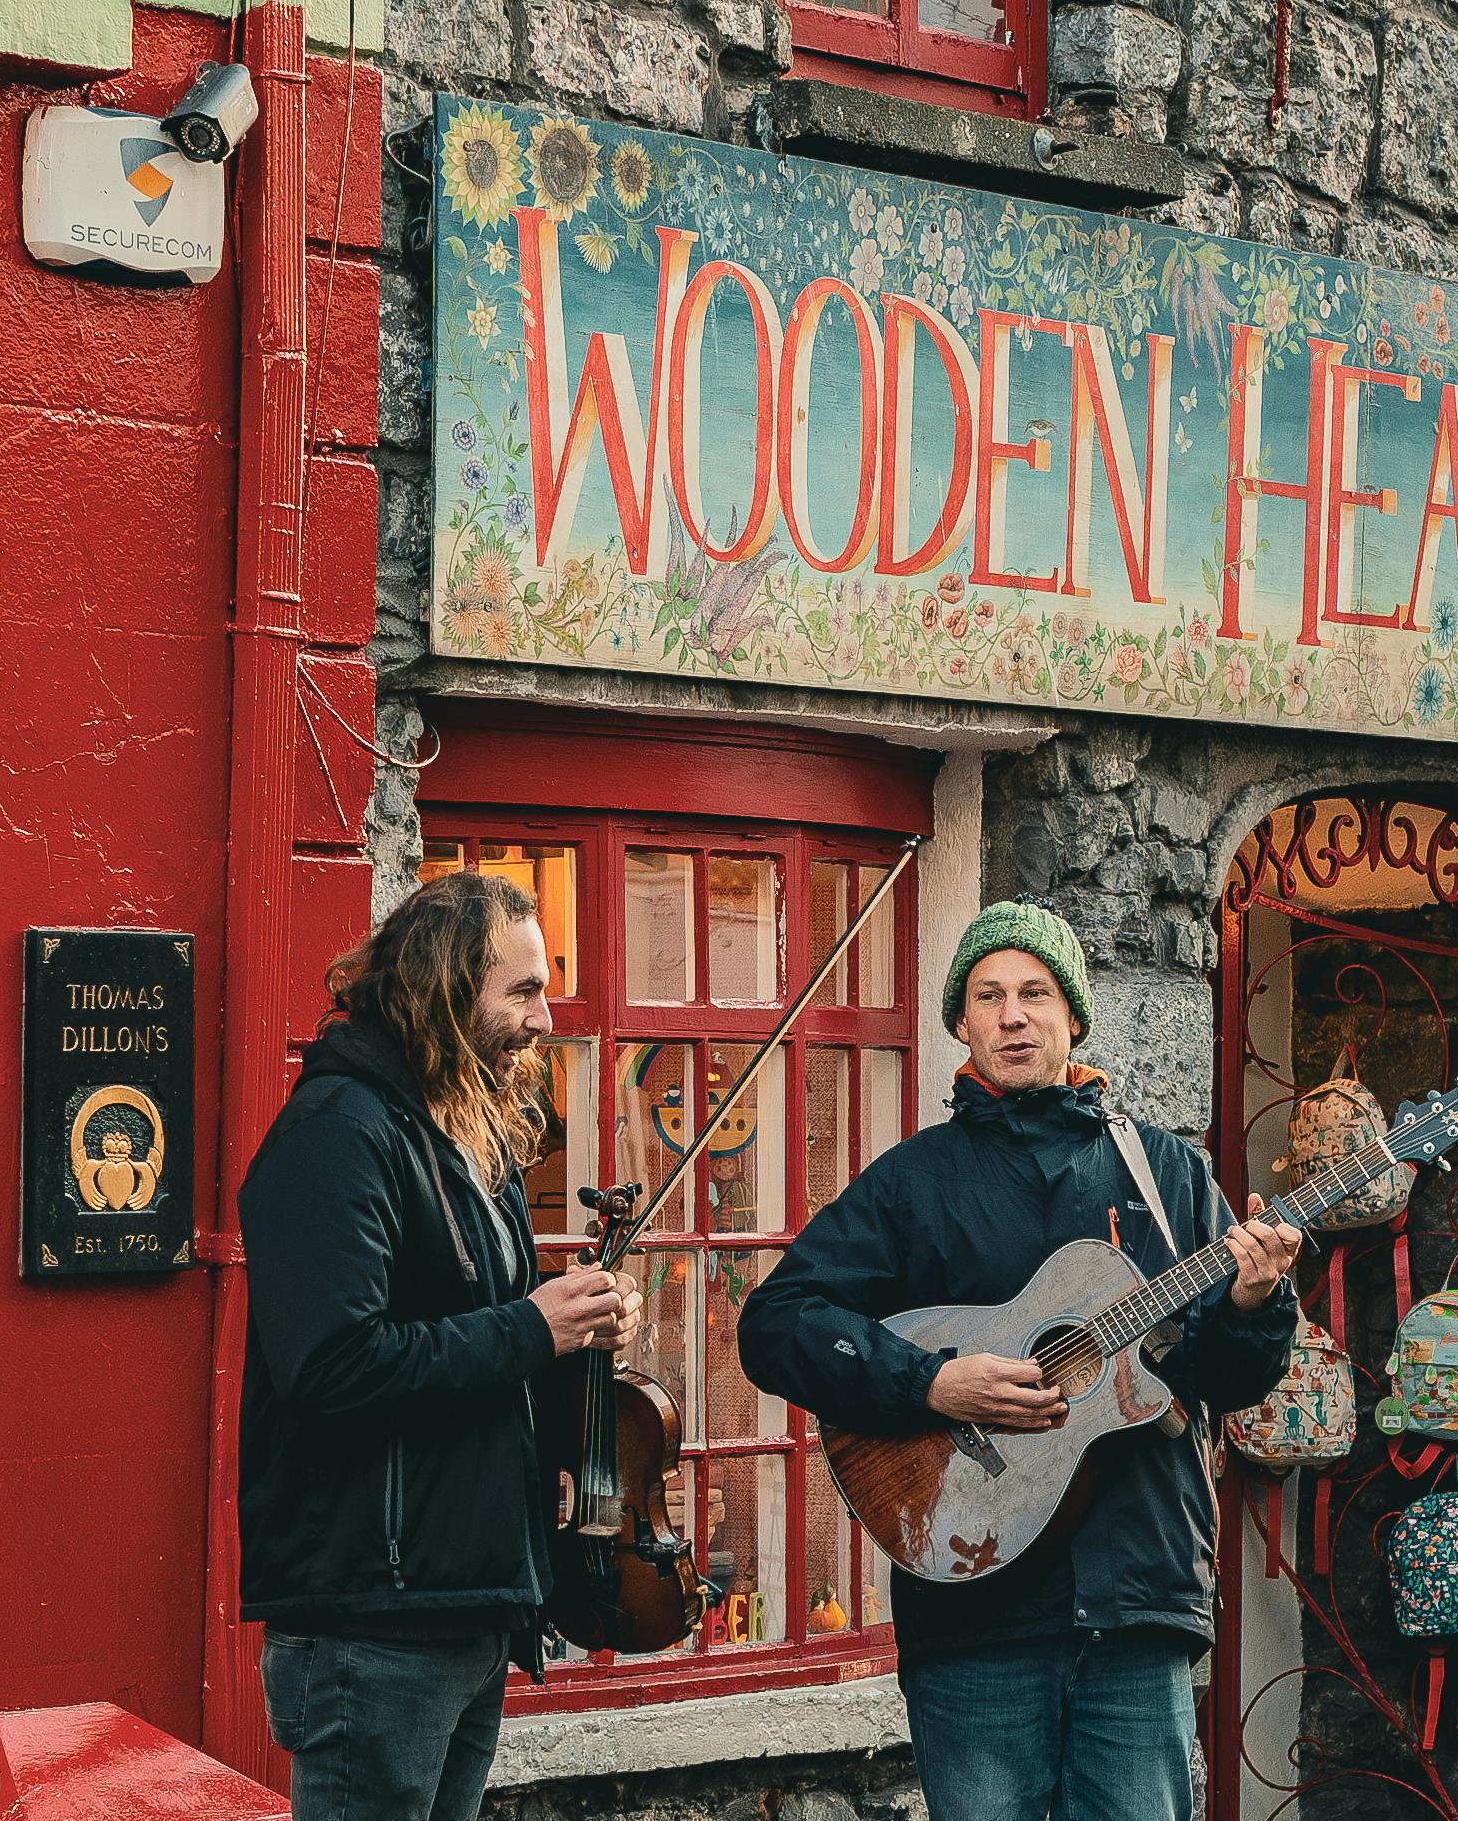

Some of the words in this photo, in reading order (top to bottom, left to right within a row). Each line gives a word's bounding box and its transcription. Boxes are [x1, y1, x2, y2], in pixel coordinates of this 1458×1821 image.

[71, 224, 212, 262] SECURECOM
[509, 206, 1176, 606] WOODEN
[66, 984, 165, 1012] THOMAS
[62, 1025, 170, 1055] DILLON'S
